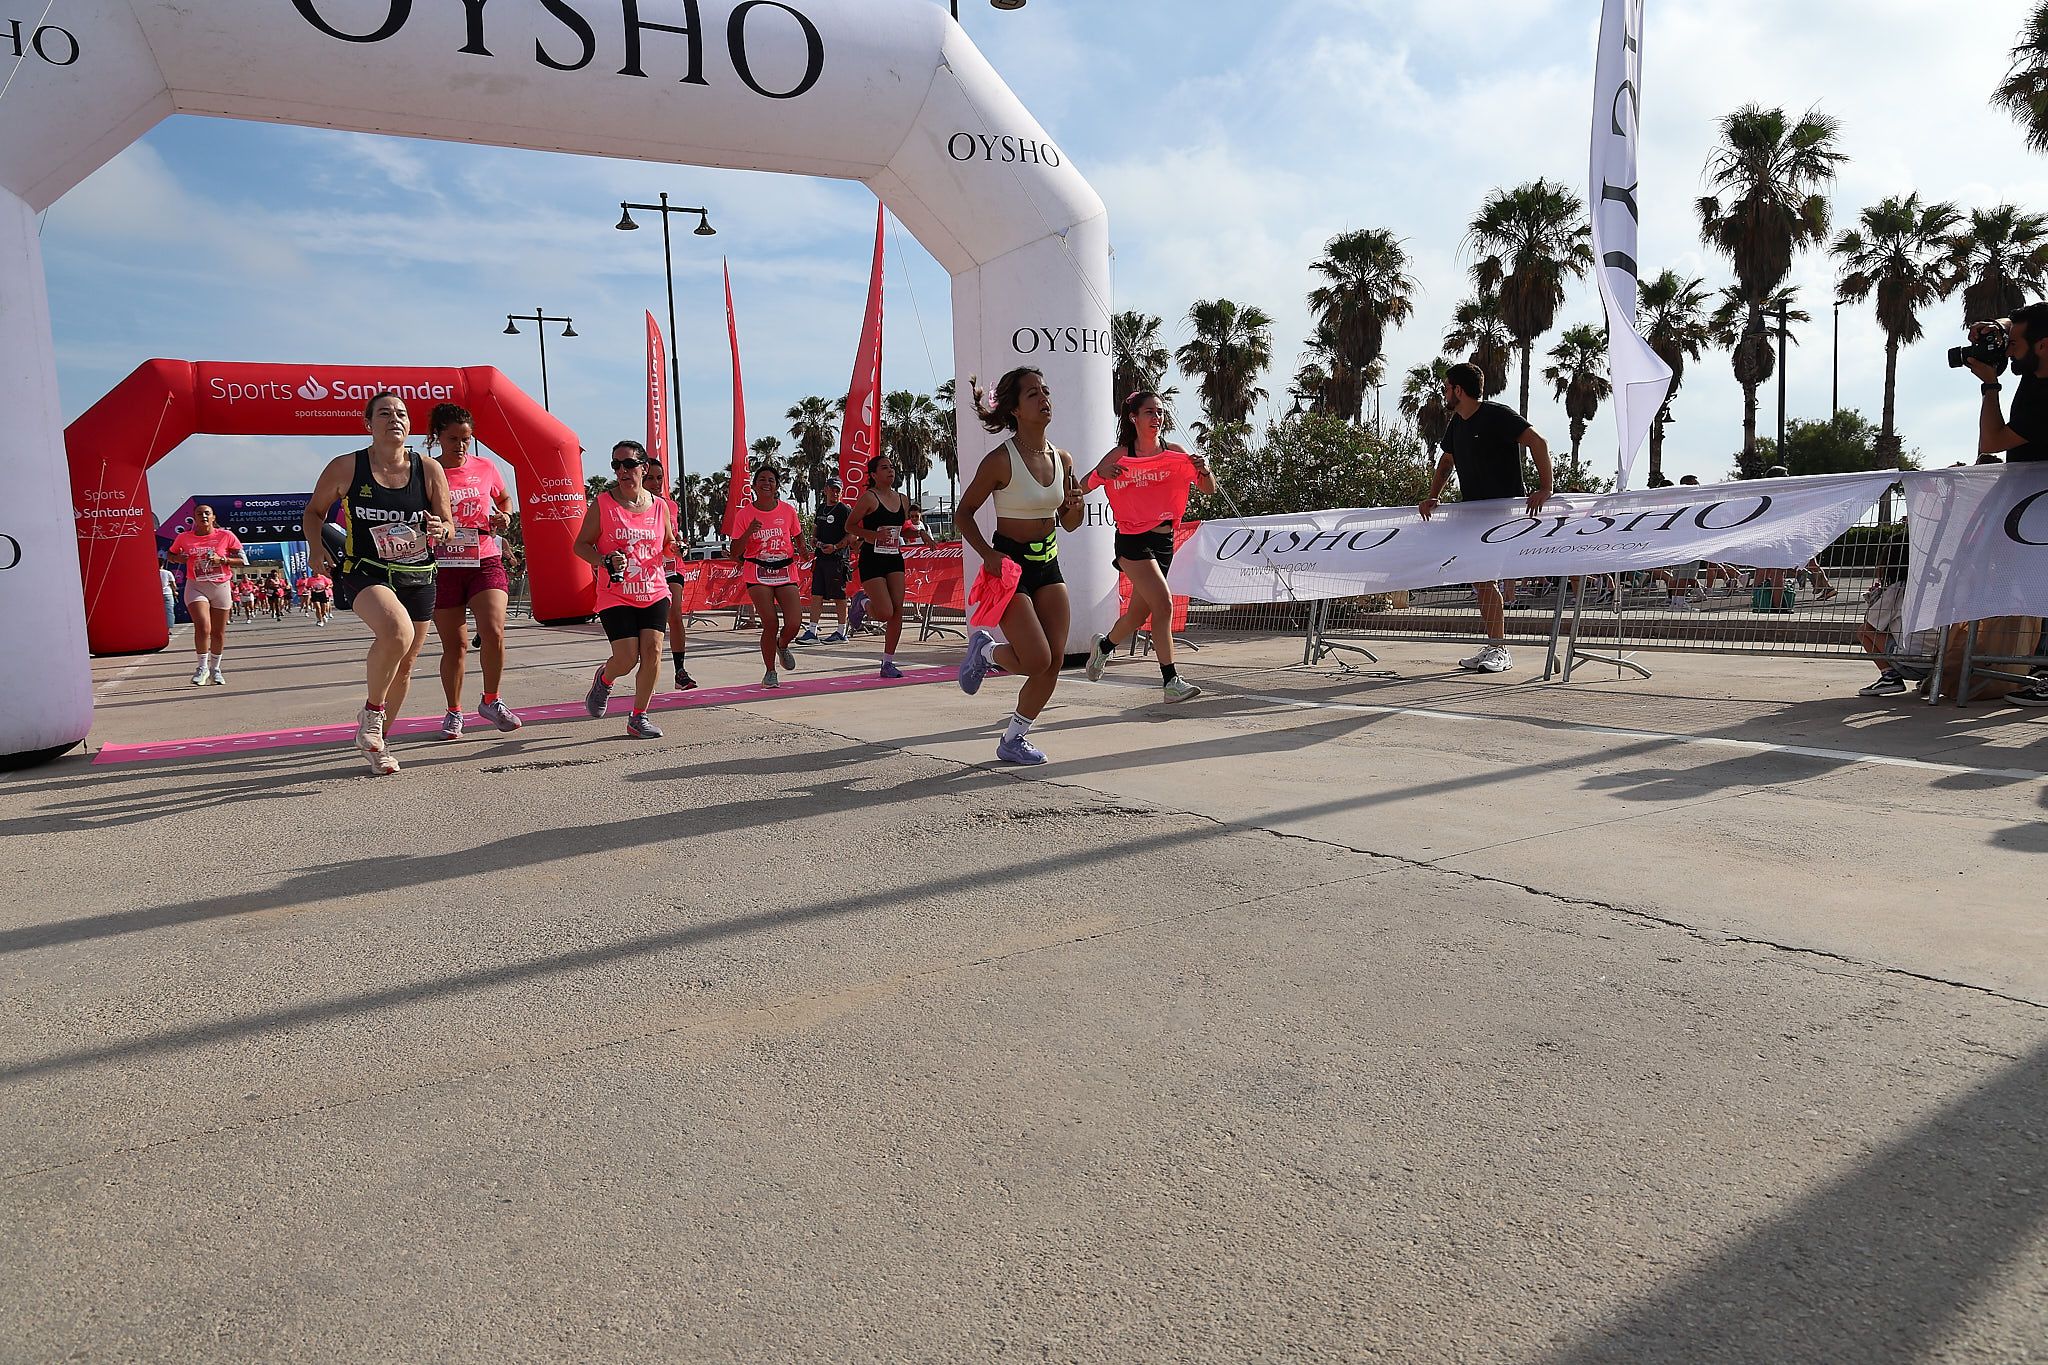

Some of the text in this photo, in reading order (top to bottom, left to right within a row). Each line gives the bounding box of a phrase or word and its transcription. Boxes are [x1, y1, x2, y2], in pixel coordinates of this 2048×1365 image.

[947, 132, 1061, 168] OYSHO
[1012, 327, 1112, 357] OYSHO
[209, 377, 454, 405] Sports Santander
[542, 477, 573, 489] Sports
[84, 489, 125, 502] Sports
[245, 500, 280, 508] octopus
[83, 506, 144, 519] Santander
[1480, 495, 1773, 544] OYSHO
[615, 528, 657, 540] CARRERA
[752, 527, 784, 540] CARRERA
[396, 541, 416, 552] 016
[446, 545, 465, 553] 016
[638, 543, 652, 559] DE
[770, 539, 781, 550] DE
[1216, 528, 1400, 561] OYSHO
[1518, 541, 1650, 556] WWW.OYSHO.COM
[640, 567, 650, 582] LA
